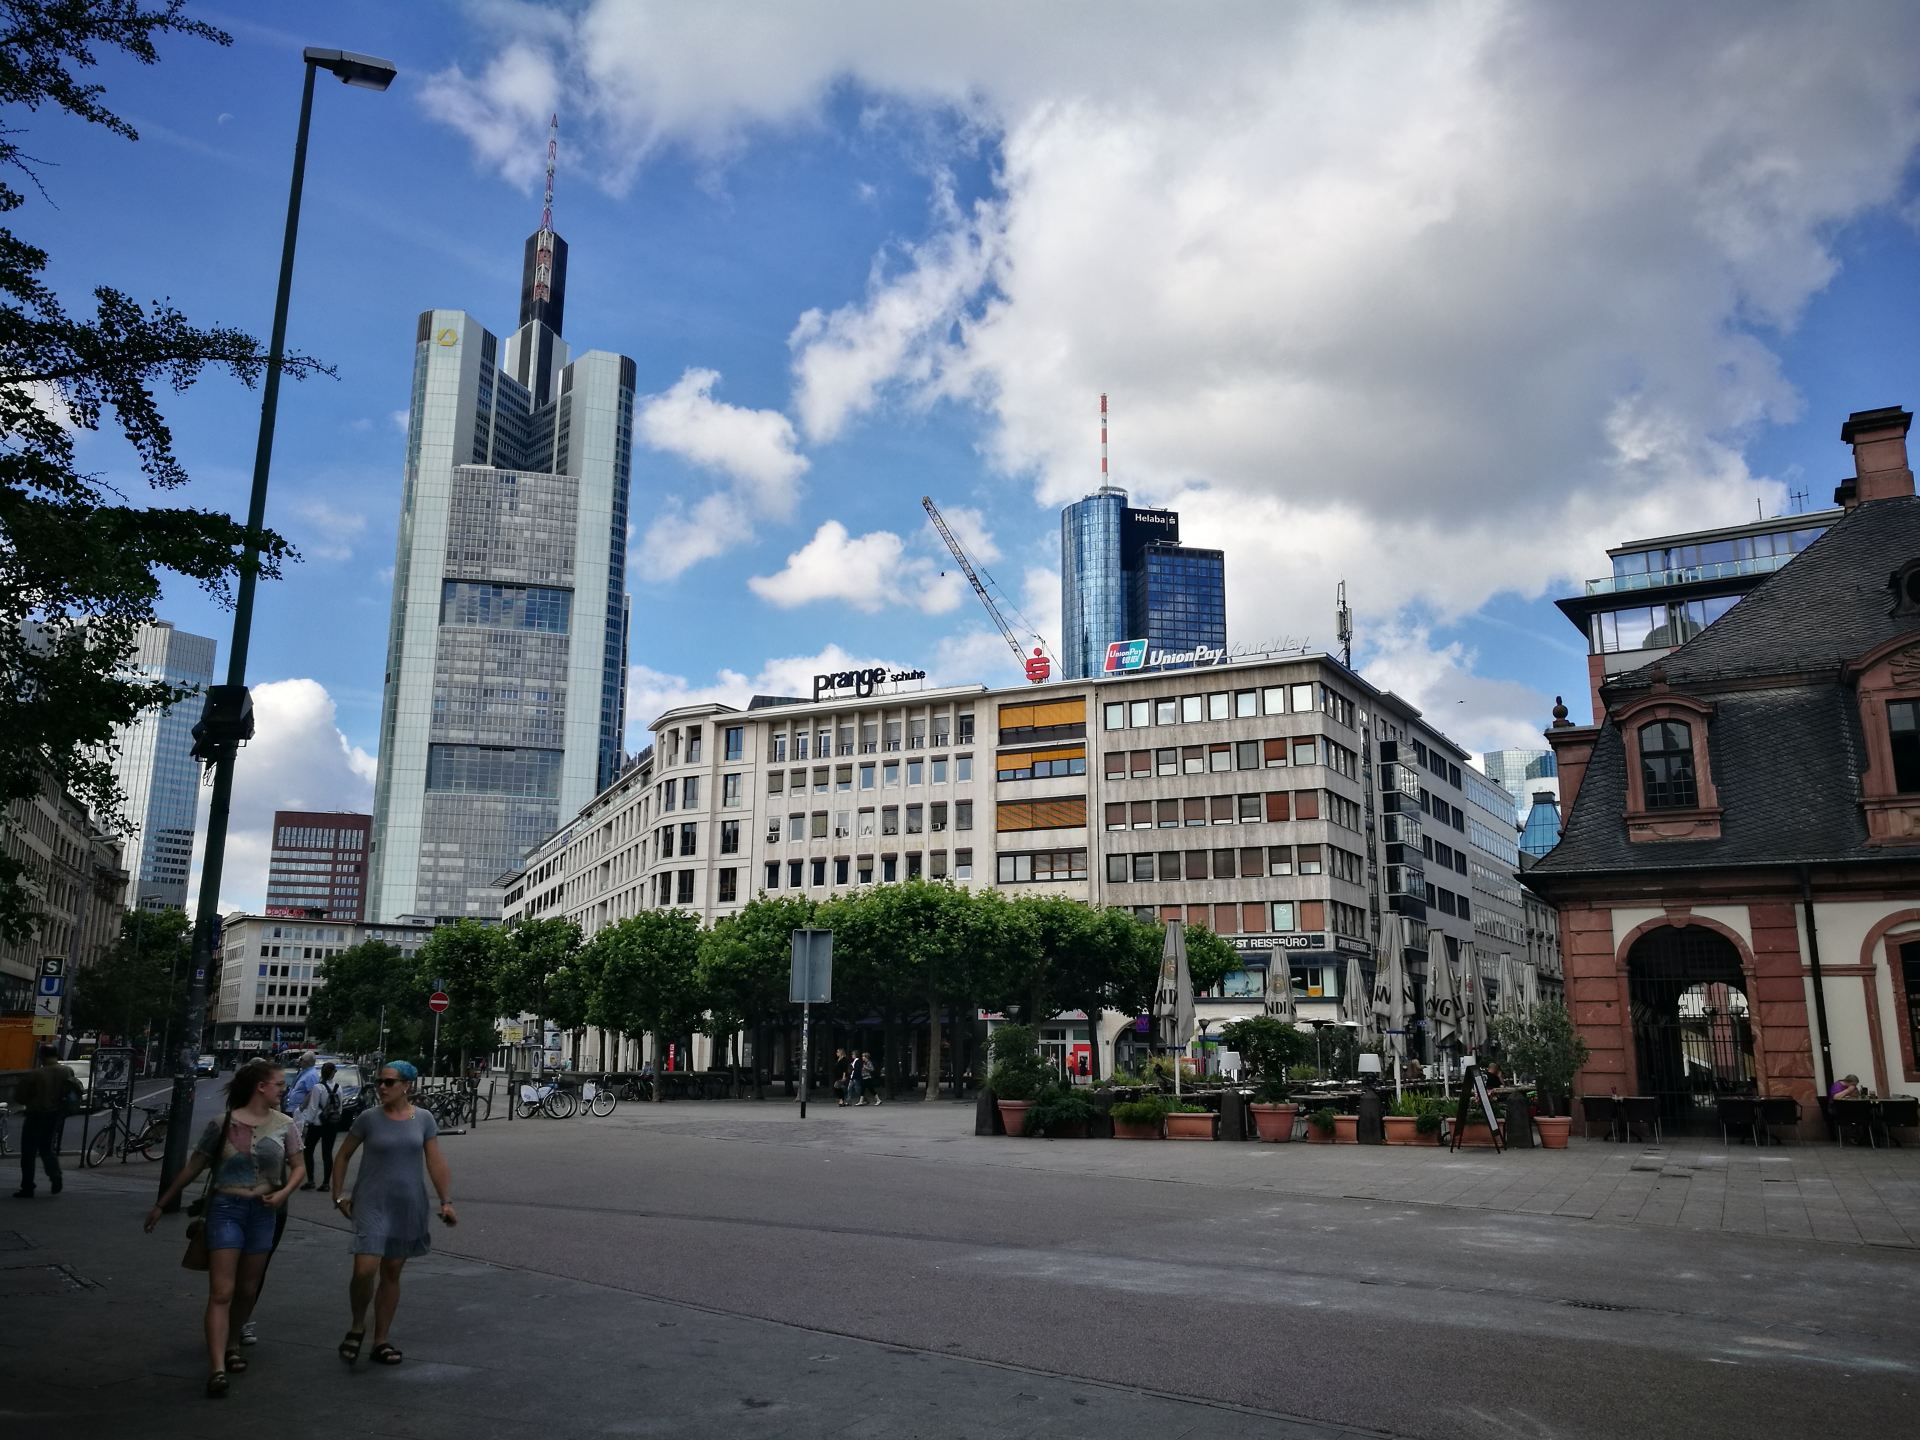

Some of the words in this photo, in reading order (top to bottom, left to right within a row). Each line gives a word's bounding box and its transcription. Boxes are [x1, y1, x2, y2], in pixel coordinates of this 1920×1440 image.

[1135, 513, 1165, 523] Helaba
[1109, 647, 1142, 658] UnionPay
[1150, 645, 1224, 665] UnionPay
[813, 667, 886, 703] prange
[890, 669, 926, 682] schuhe
[1250, 936, 1308, 948] REISEBÜRO
[46, 961, 58, 973] S
[40, 978, 60, 994] U
